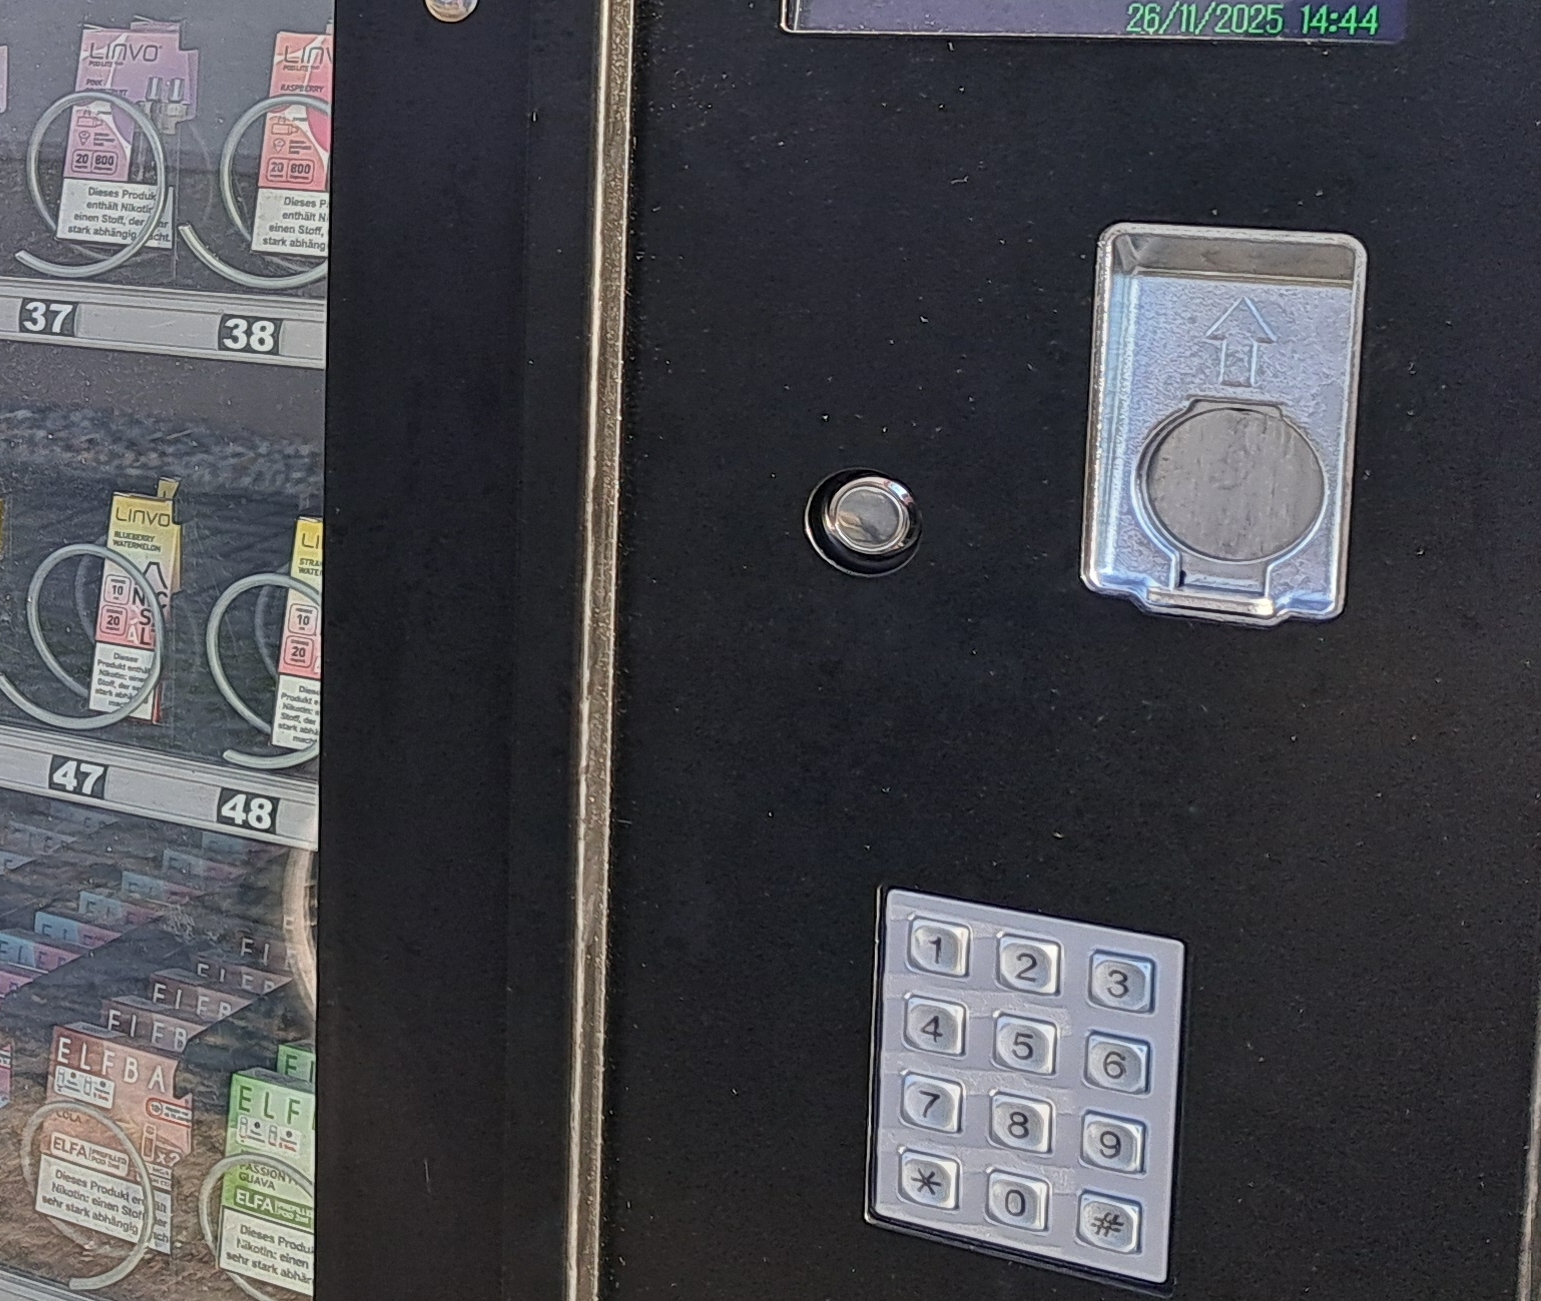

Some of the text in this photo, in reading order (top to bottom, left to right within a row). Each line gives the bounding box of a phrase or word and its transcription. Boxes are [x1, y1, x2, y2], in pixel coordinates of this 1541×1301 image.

[1126, 3, 1379, 36] 26/11/2025 14:44
[23, 303, 73, 333] 37
[223, 318, 275, 352] 38
[111, 584, 124, 596] 10
[107, 614, 120, 627] 20
[53, 760, 103, 795] 47
[221, 793, 271, 830] 48
[930, 937, 1129, 998] 1 2 3
[920, 1016, 1126, 1079] 4 5 6
[919, 1090, 1122, 1159] 7 8 9
[53, 1135, 89, 1161] ELFA
[55, 1169, 131, 1202] Dieses Produkt
[238, 1173, 275, 1191] GUAVA
[42, 1195, 64, 1210] sehr
[67, 1200, 94, 1219] stark
[91, 1195, 119, 1212] einen
[235, 1190, 273, 1214] ELFA
[1005, 1190, 1025, 1216] 0
